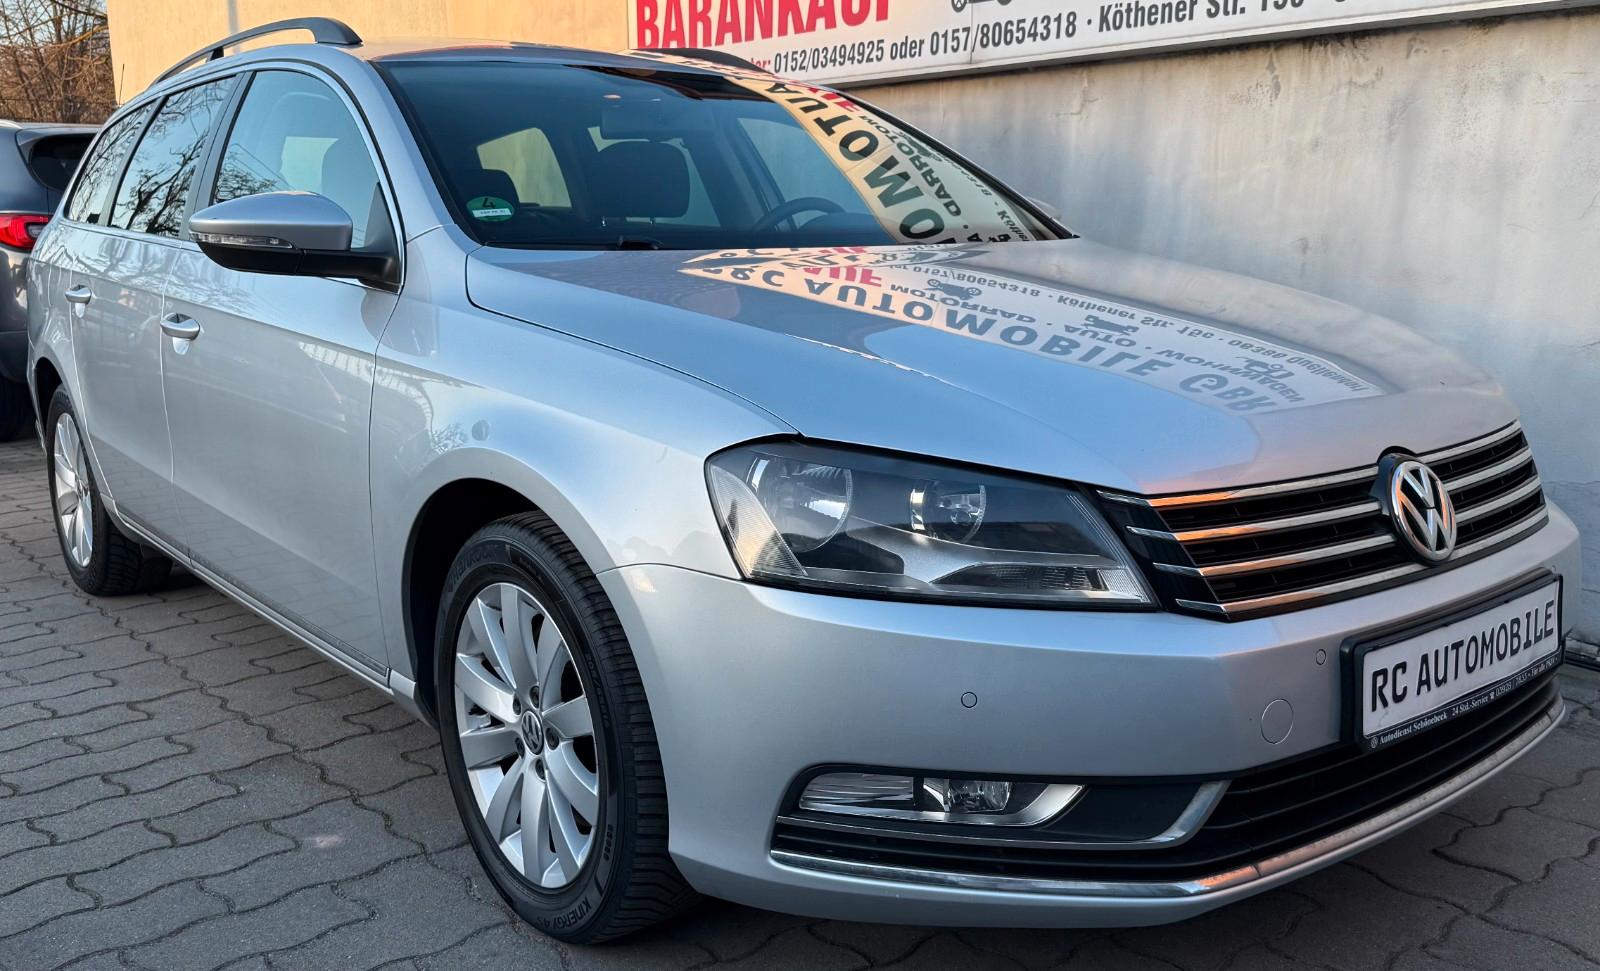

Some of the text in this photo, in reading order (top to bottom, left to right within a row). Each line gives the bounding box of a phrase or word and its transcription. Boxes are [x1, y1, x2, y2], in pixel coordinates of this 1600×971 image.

[774, 39, 885, 73] 0152/03494925
[890, 36, 925, 60] oder
[930, 11, 1077, 55] 0157/80654318
[1098, 0, 1199, 32] Köthener
[1371, 600, 1554, 712] RC AUTOMOBILE
